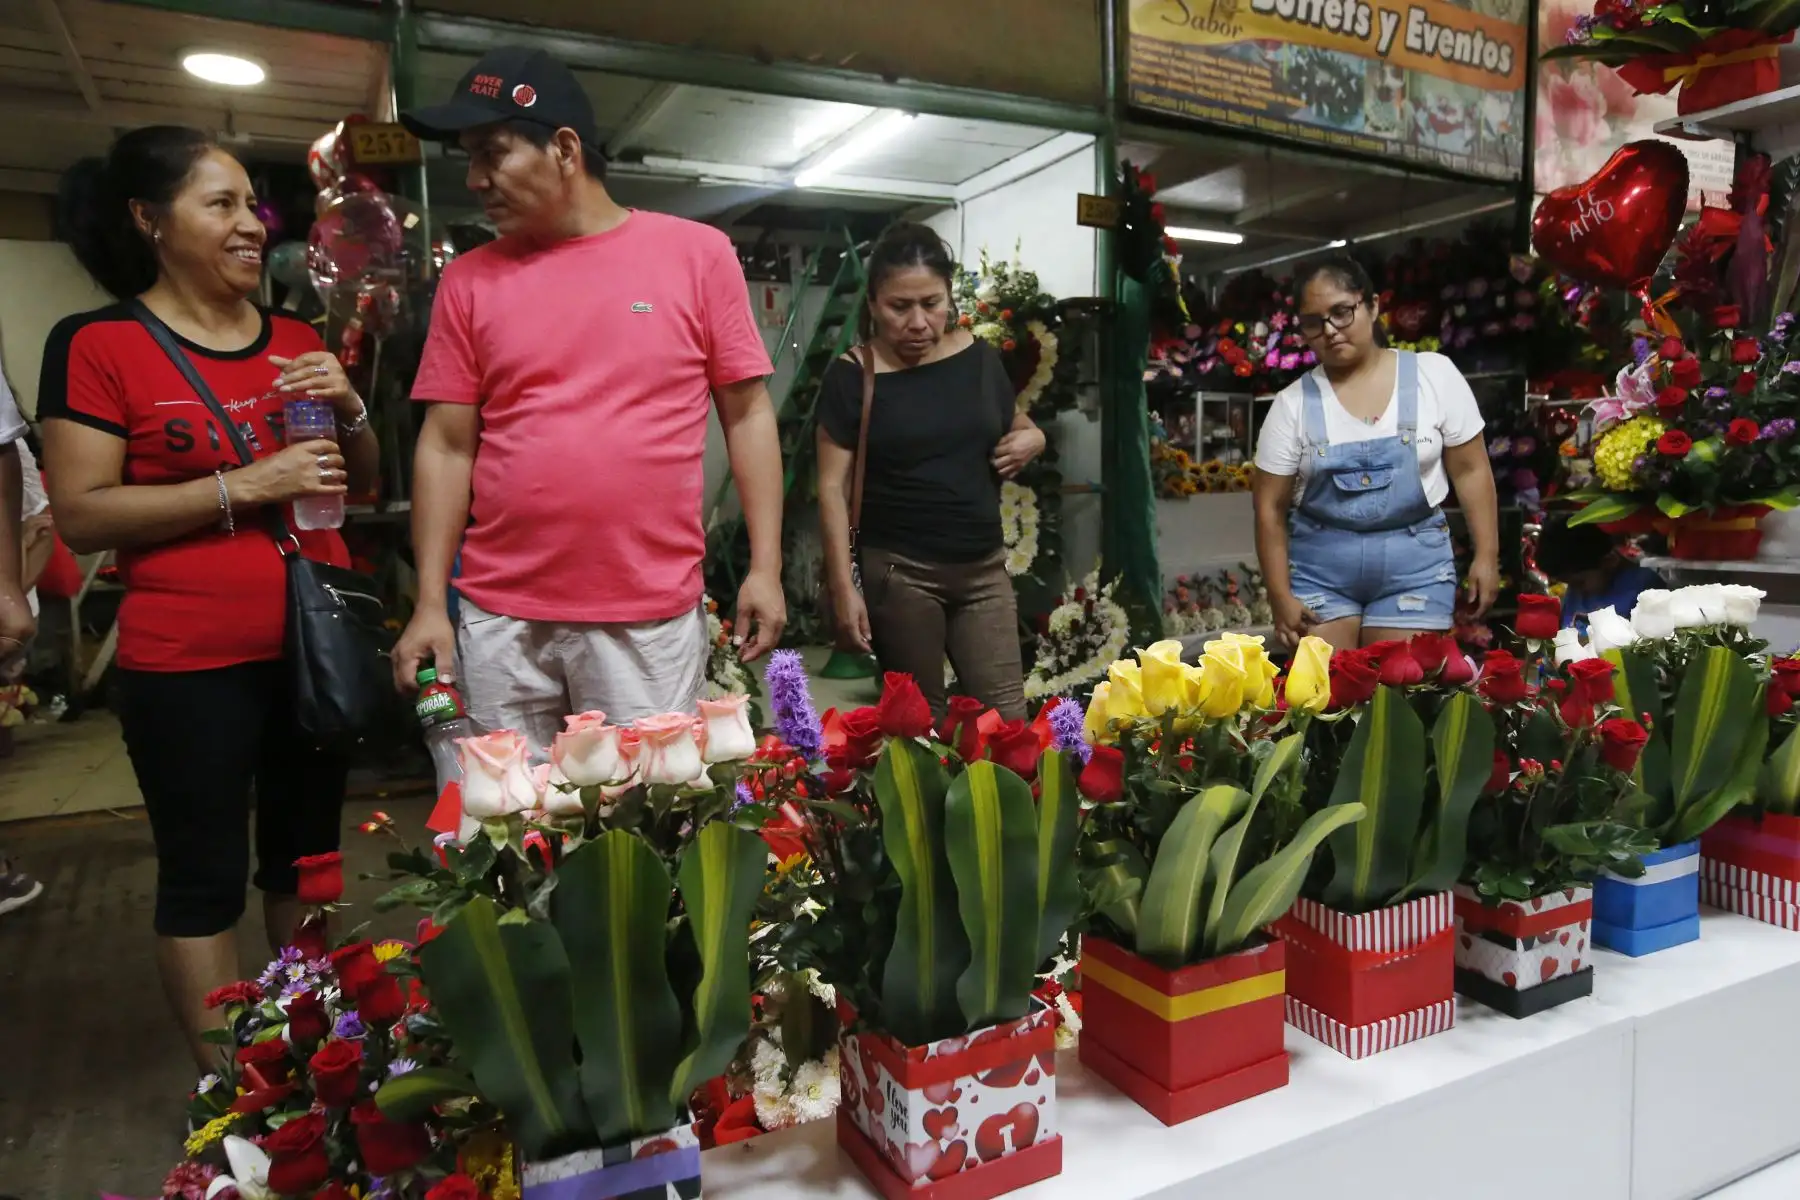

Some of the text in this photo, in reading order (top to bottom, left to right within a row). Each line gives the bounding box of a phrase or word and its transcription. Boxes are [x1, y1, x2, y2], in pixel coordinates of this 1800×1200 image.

[1376, 7, 1401, 58] y
[1405, 5, 1514, 77] Eventos
[470, 84, 501, 98] PLATE
[474, 74, 503, 88] RIVER
[359, 132, 406, 156] 257
[1572, 187, 1600, 213] TE
[1569, 199, 1615, 243] AMO
[998, 1122, 1016, 1157] I
